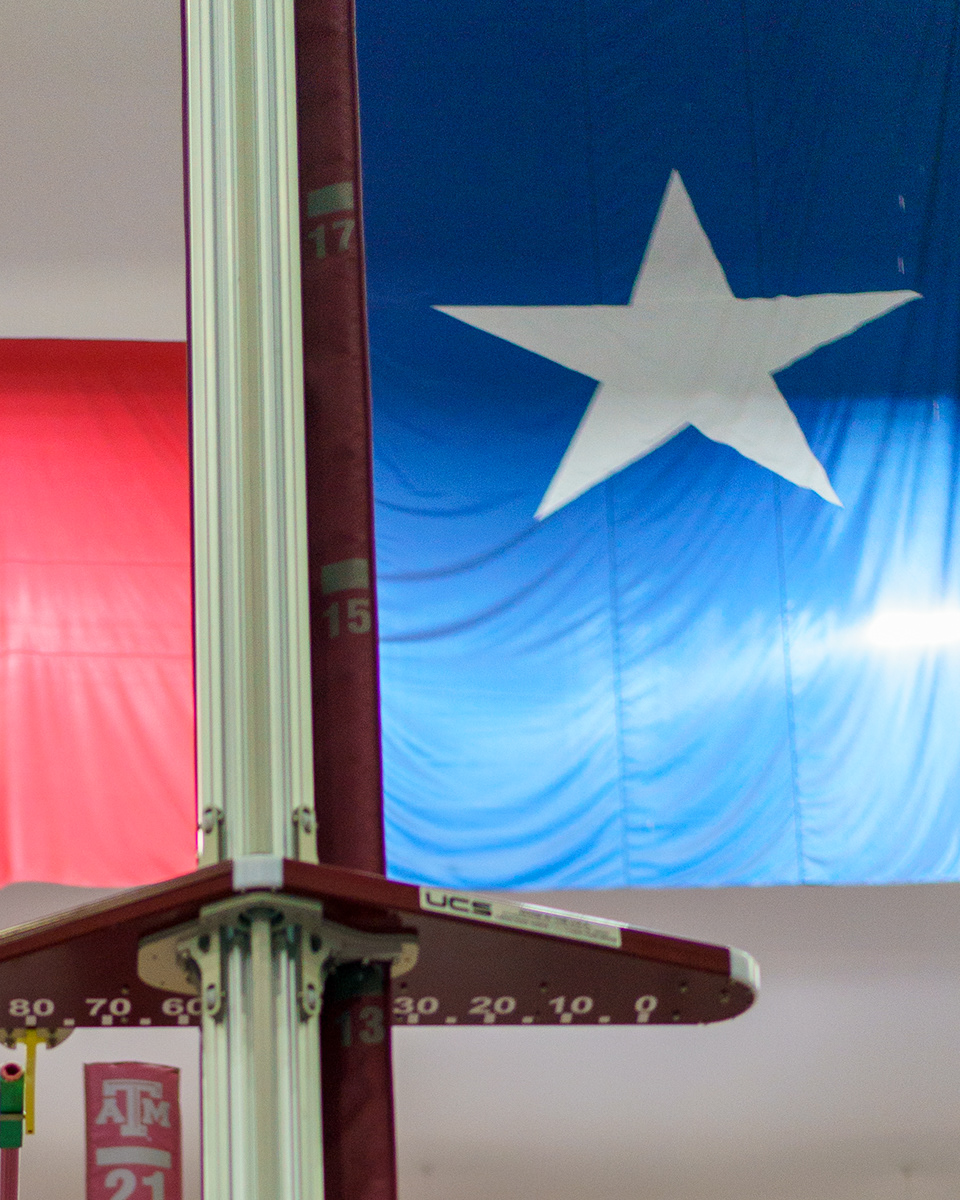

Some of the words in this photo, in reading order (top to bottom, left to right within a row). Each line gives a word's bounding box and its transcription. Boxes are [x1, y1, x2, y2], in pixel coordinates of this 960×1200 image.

[307, 218, 356, 260] 17
[321, 599, 372, 638] 15
[425, 891, 492, 917] UCS
[9, 998, 55, 1017] 80
[85, 998, 132, 1016] 70
[393, 996, 439, 1015] 30
[468, 996, 517, 1015] 20
[548, 996, 594, 1015] 10
[634, 995, 658, 1014] 0
[335, 1005, 385, 1047] 13
